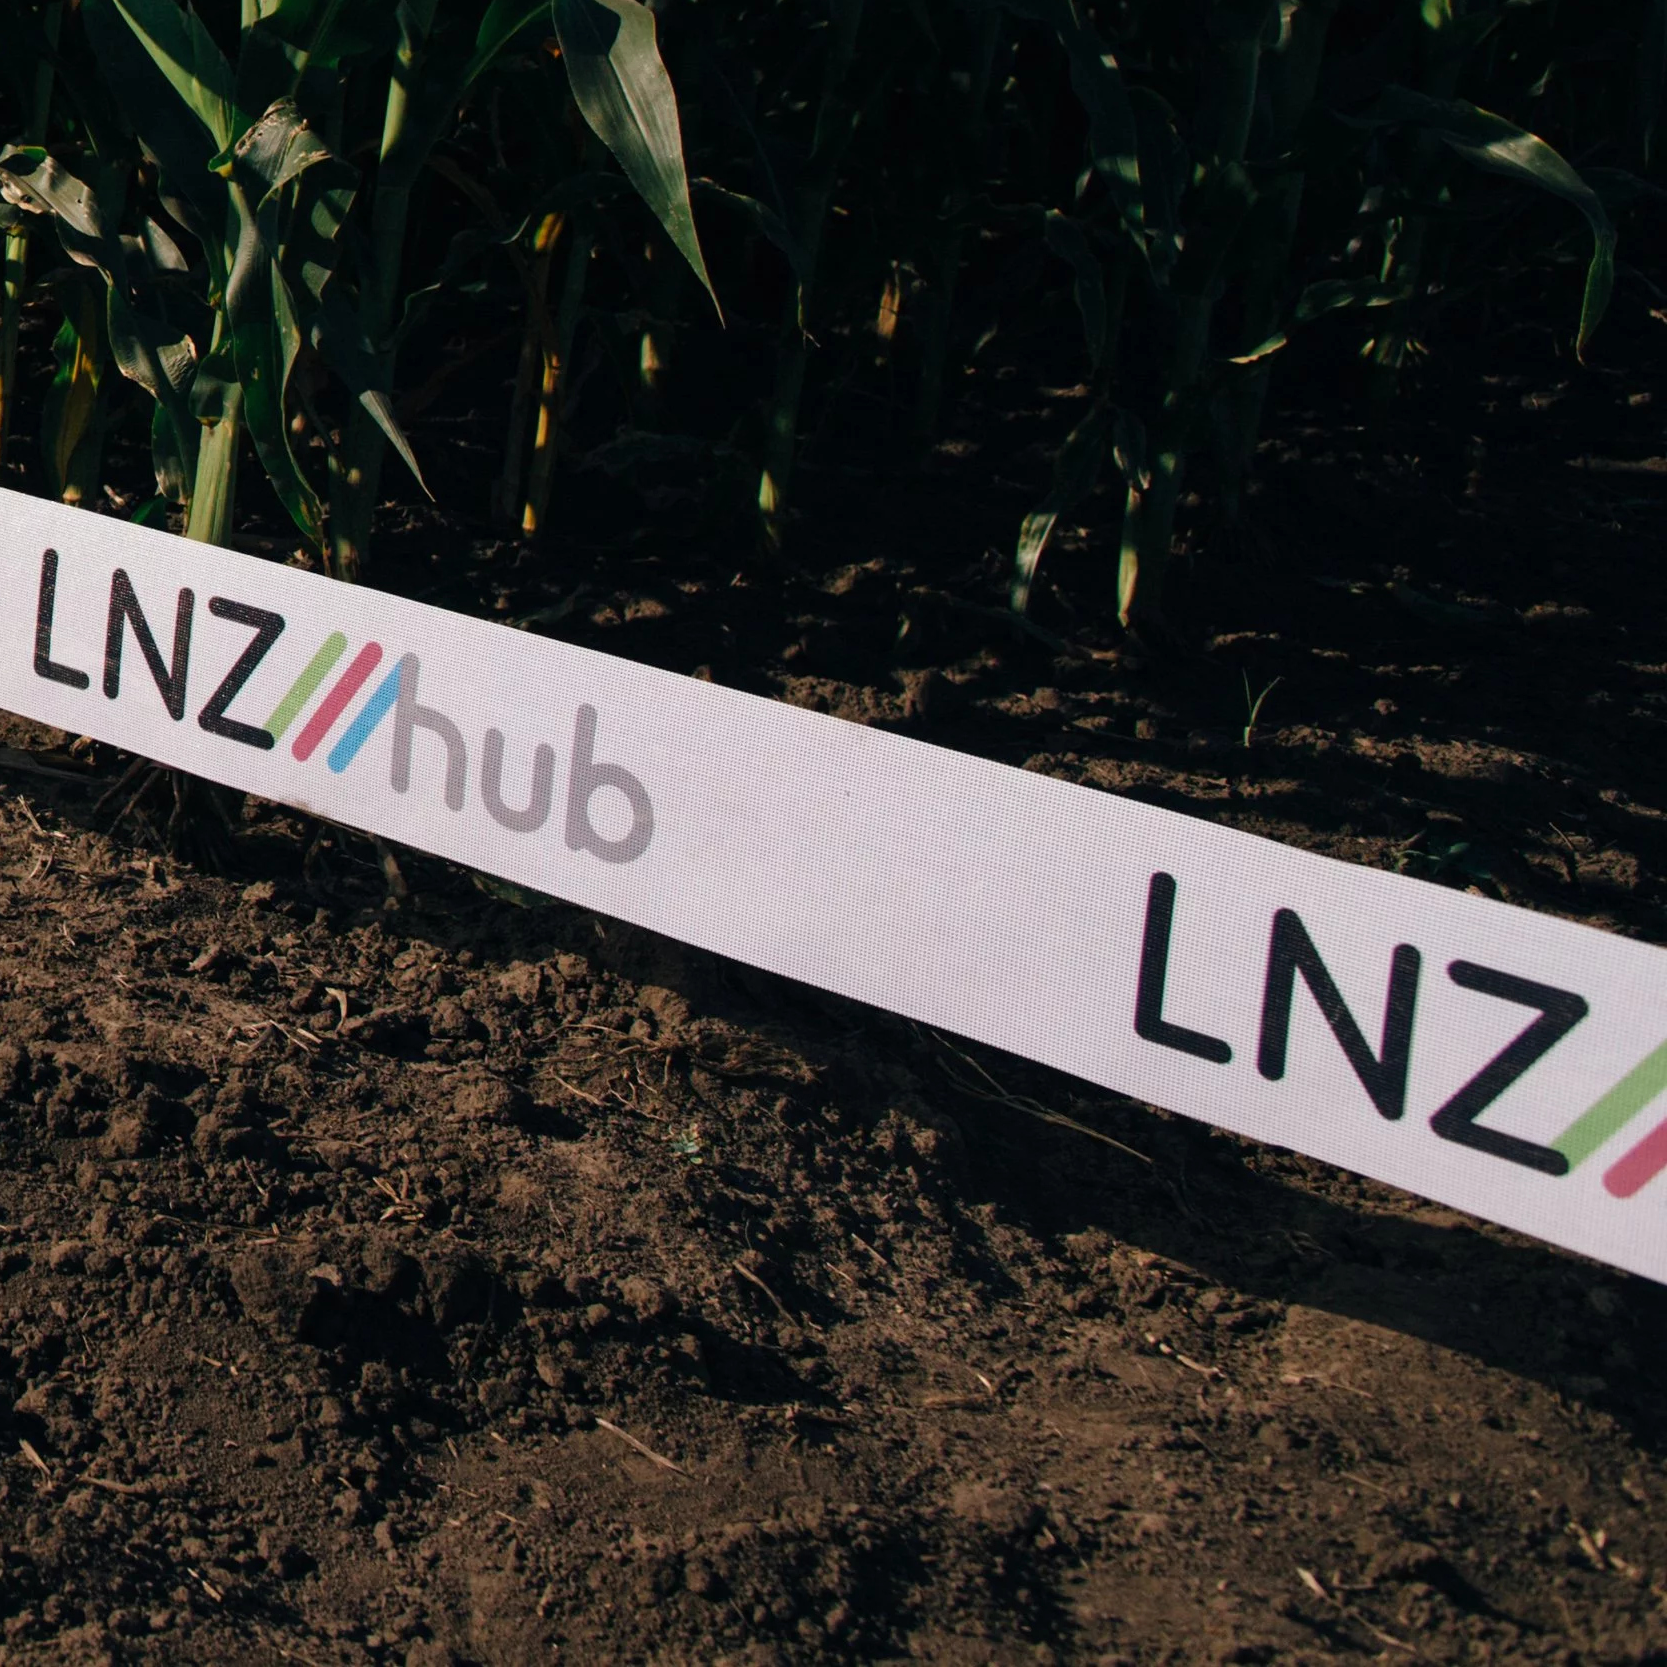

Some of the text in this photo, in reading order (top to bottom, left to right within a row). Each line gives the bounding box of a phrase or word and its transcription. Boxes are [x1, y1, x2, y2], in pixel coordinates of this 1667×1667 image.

[33, 547, 655, 865] LNZ hub
[1134, 871, 1589, 1177] LNZ
